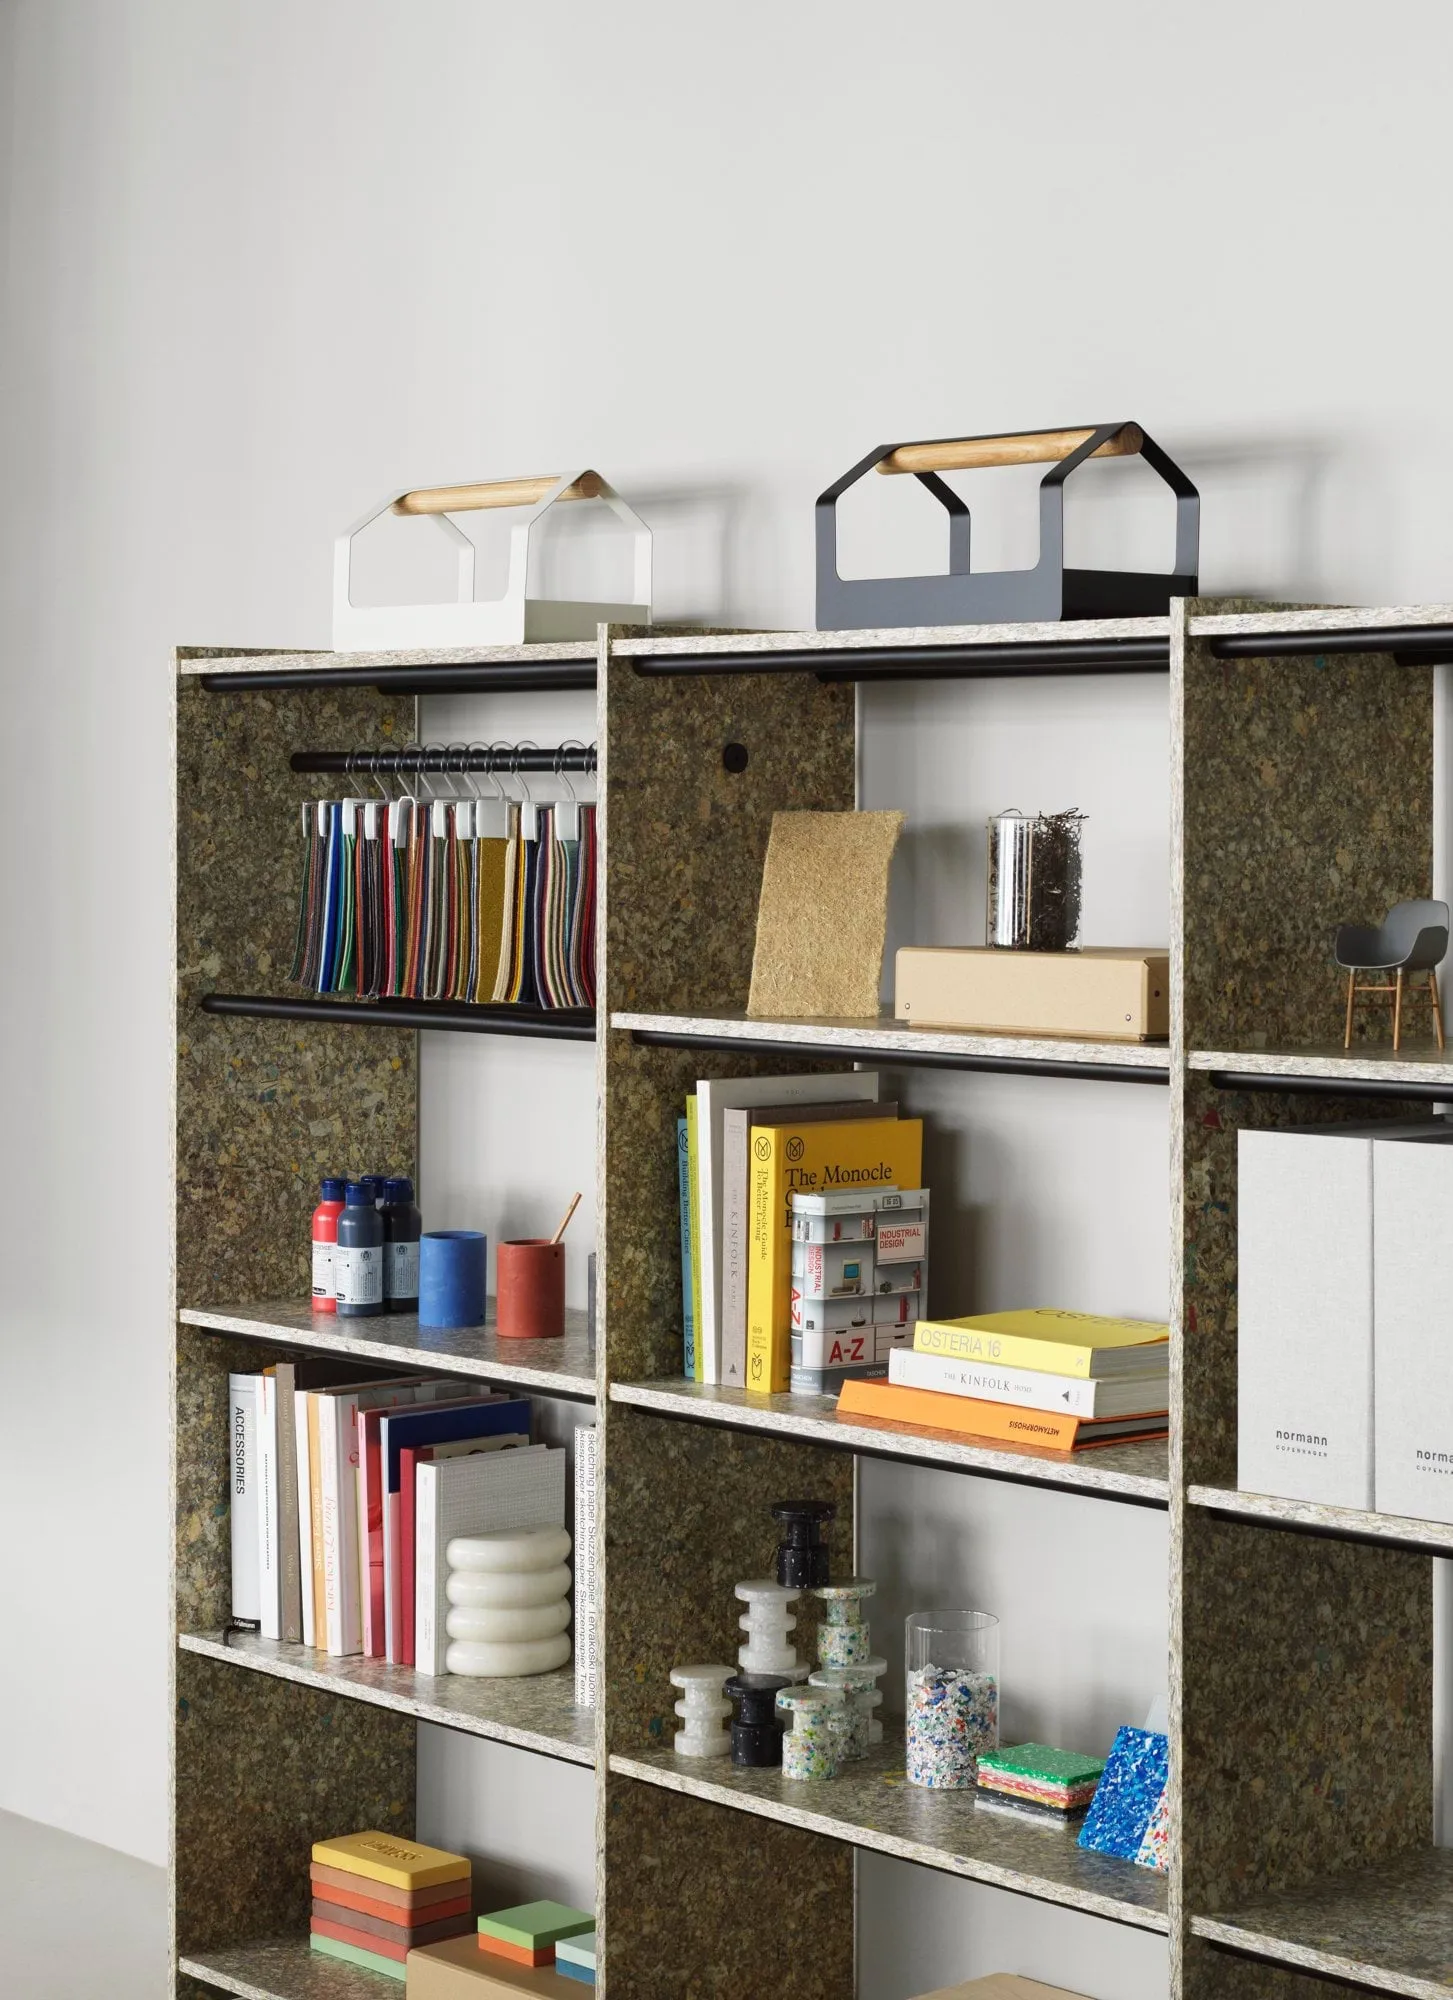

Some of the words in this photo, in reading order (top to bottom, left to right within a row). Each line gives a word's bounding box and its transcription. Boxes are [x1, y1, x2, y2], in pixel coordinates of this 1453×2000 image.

[681, 1160, 689, 1197] Building
[761, 1168, 769, 1188] The
[785, 1168, 817, 1187] The
[823, 1162, 892, 1185] Monocle
[761, 1190, 769, 1230] Monocle
[754, 1211, 762, 1241] Living
[880, 1228, 921, 1240] INDUSTRIAL
[731, 1210, 739, 1279] KINFOLK
[880, 1239, 905, 1249] DESIGN
[814, 1245, 823, 1293] INDUSTRIAL
[791, 1286, 801, 1326] A-Z
[828, 1337, 865, 1364] A-Z
[920, 1328, 983, 1357] OSTERIA
[986, 1340, 1001, 1358] 16
[943, 1371, 956, 1381] THE
[960, 1372, 1011, 1392] KINFOLK
[1008, 1420, 1061, 1436] METAMORPHOSIS
[1276, 1429, 1328, 1446] normann
[235, 1406, 245, 1495] ACCESSORIES
[587, 1433, 596, 1487] sketching
[1275, 1445, 1328, 1458] COPENHAGEN
[587, 1490, 596, 1523] paper
[587, 1526, 596, 1605] Skizzenpapier
